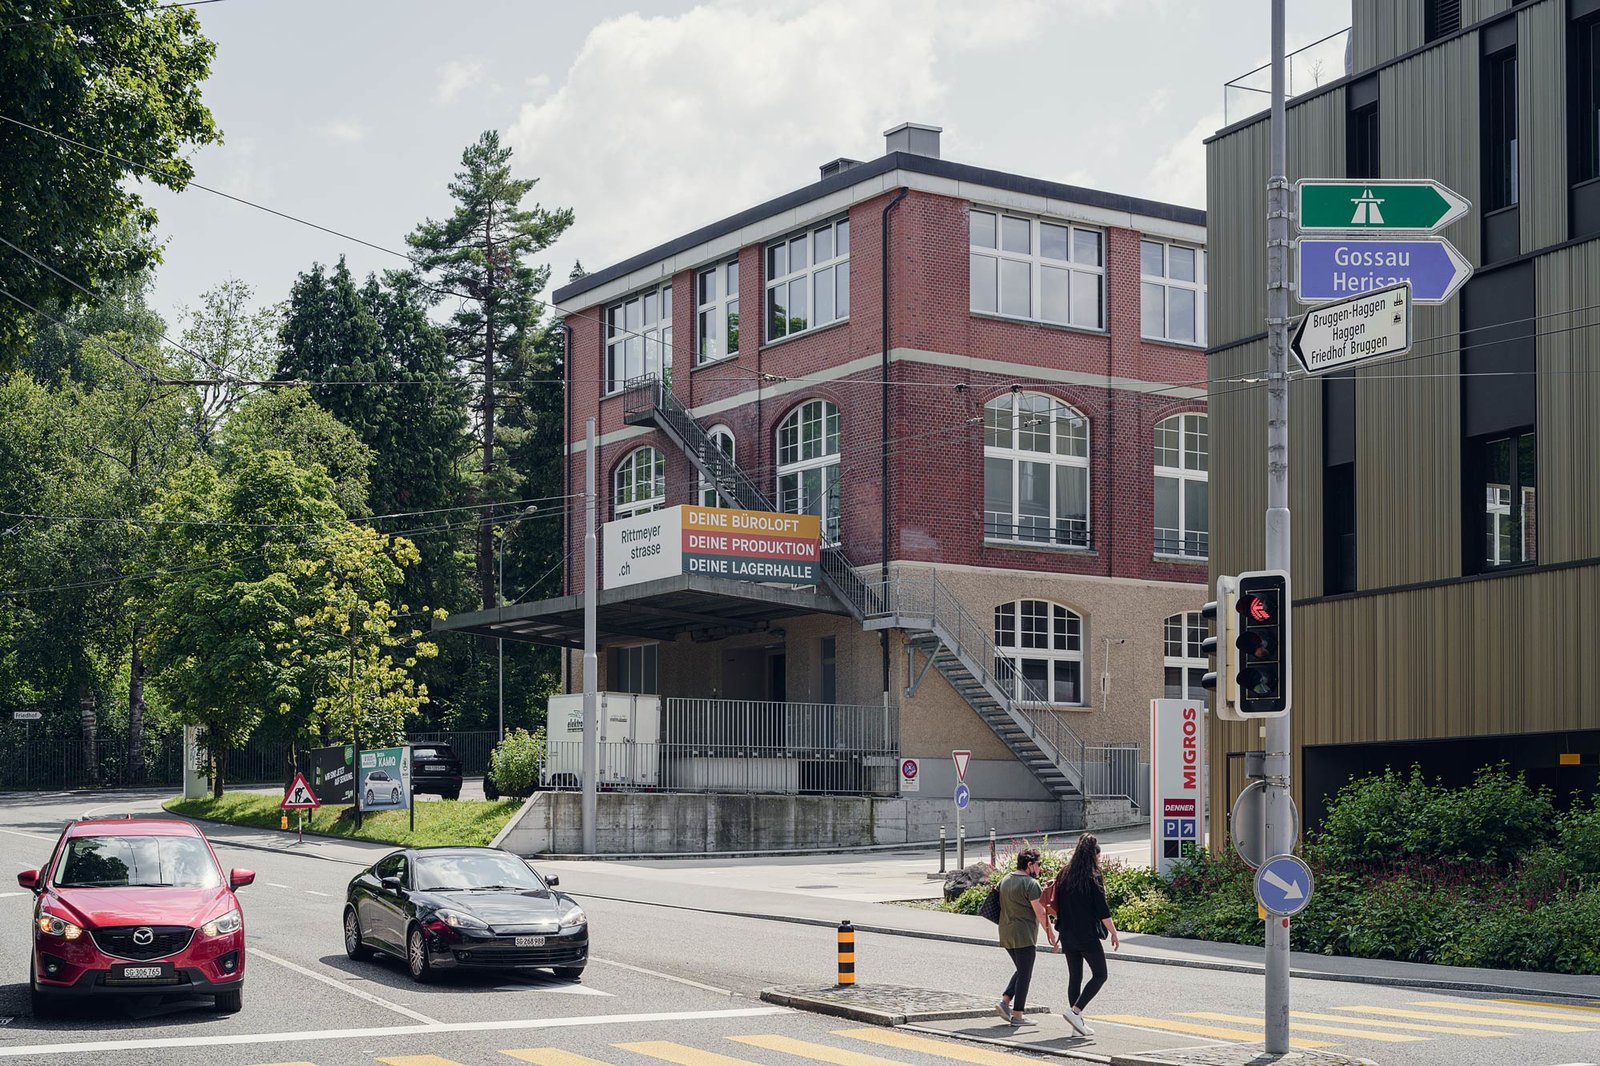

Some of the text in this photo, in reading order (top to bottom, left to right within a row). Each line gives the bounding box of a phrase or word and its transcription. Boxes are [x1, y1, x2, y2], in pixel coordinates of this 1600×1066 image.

[1334, 246, 1410, 267] Gossau
[1313, 299, 1386, 328] Bruggen-Haggen
[1332, 323, 1365, 342] Haggen
[1311, 335, 1388, 364] Friedhof Bruggen
[689, 511, 800, 533] DEINE BÜROLOFT
[621, 524, 661, 544] Rittmeyer
[630, 543, 661, 560] strasse
[689, 535, 815, 556] DEINE PRODUKTION
[618, 561, 631, 577] .ch
[689, 558, 812, 579] DEINE LAGERHALLE
[1183, 707, 1197, 789] MIGROS
[1164, 804, 1195, 812] DENNER
[1167, 822, 1176, 835] P
